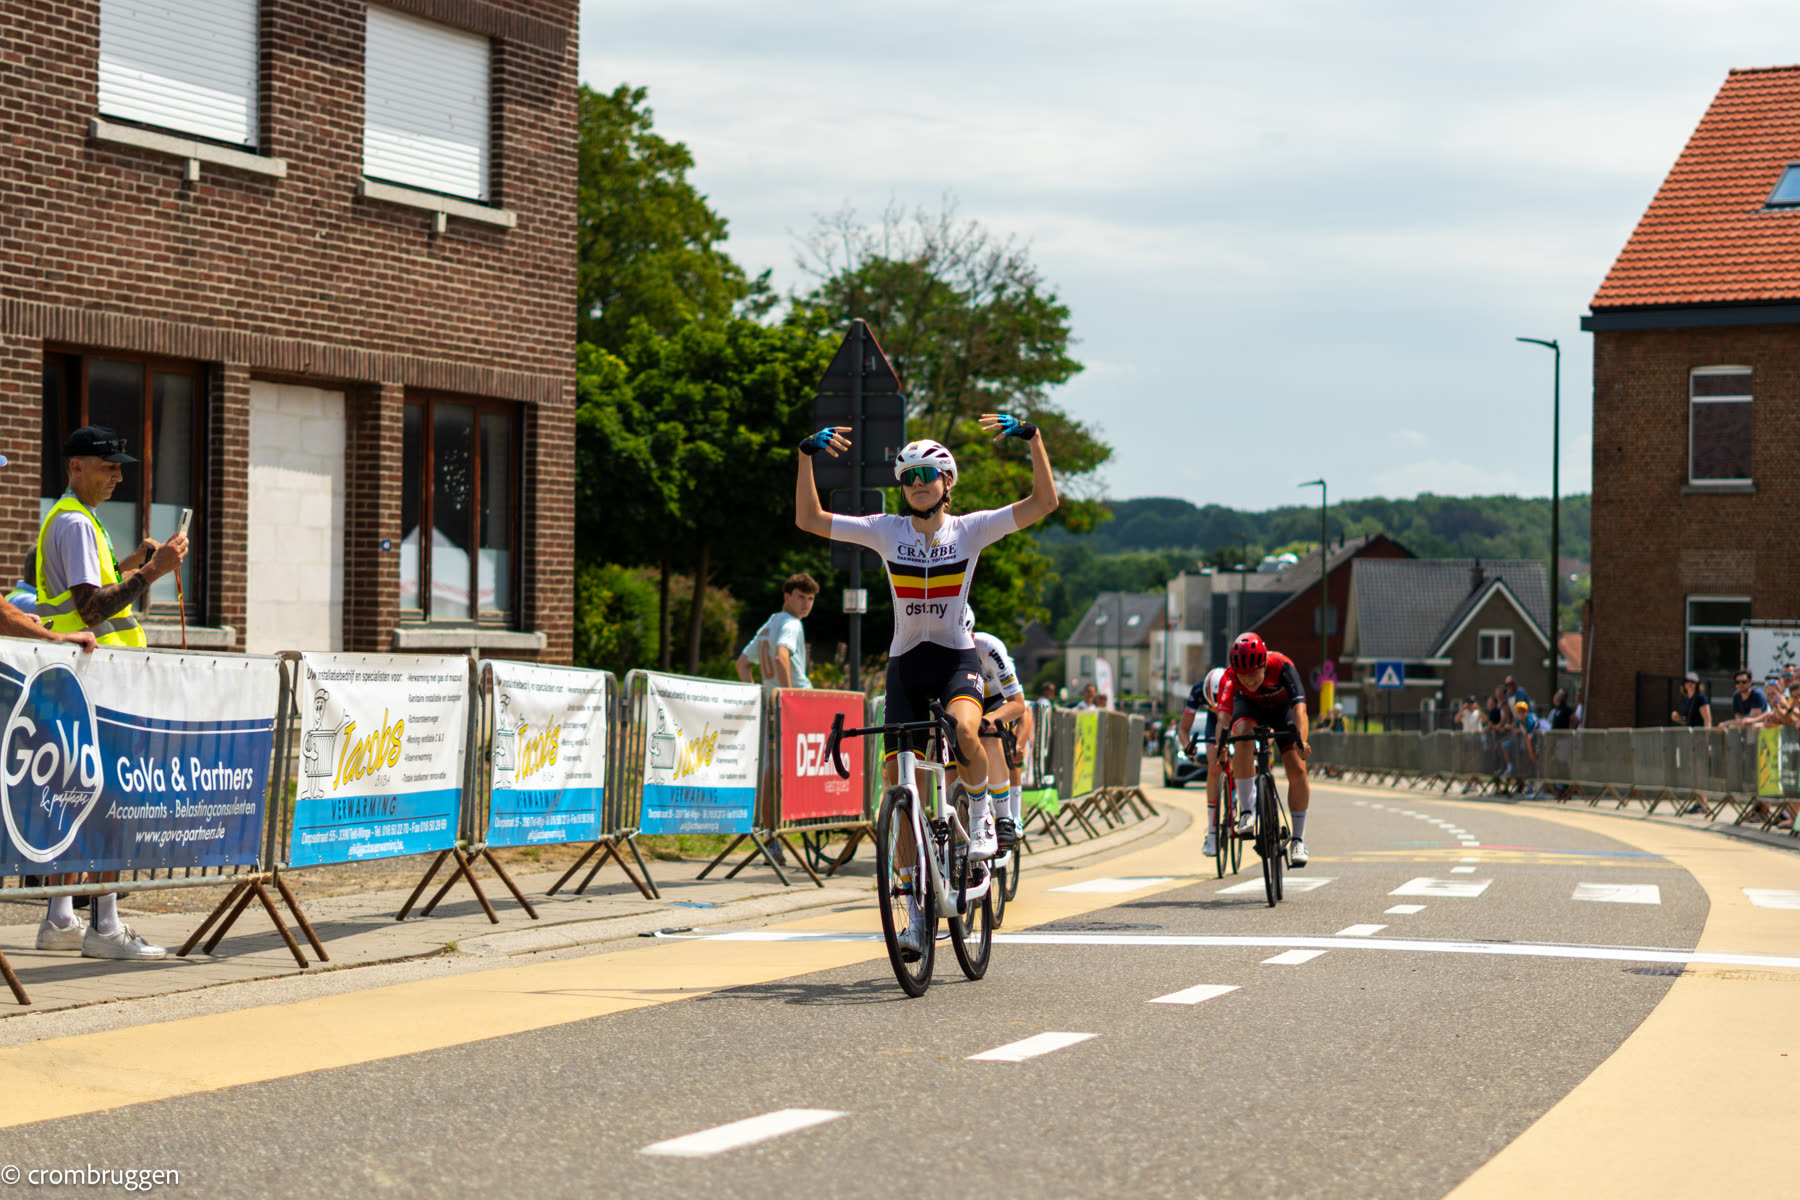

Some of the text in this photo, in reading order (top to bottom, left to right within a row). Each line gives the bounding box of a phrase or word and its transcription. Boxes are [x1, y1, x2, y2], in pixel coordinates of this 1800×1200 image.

[5, 716, 97, 788] GoVa
[333, 708, 404, 790] Jacobs
[515, 714, 561, 782] Jacobs
[117, 756, 253, 793] GoVa & Partners
[105, 802, 168, 820] Accountants
[175, 798, 256, 822] Belastingconsulenten
[331, 796, 397, 820] VERWARMING
